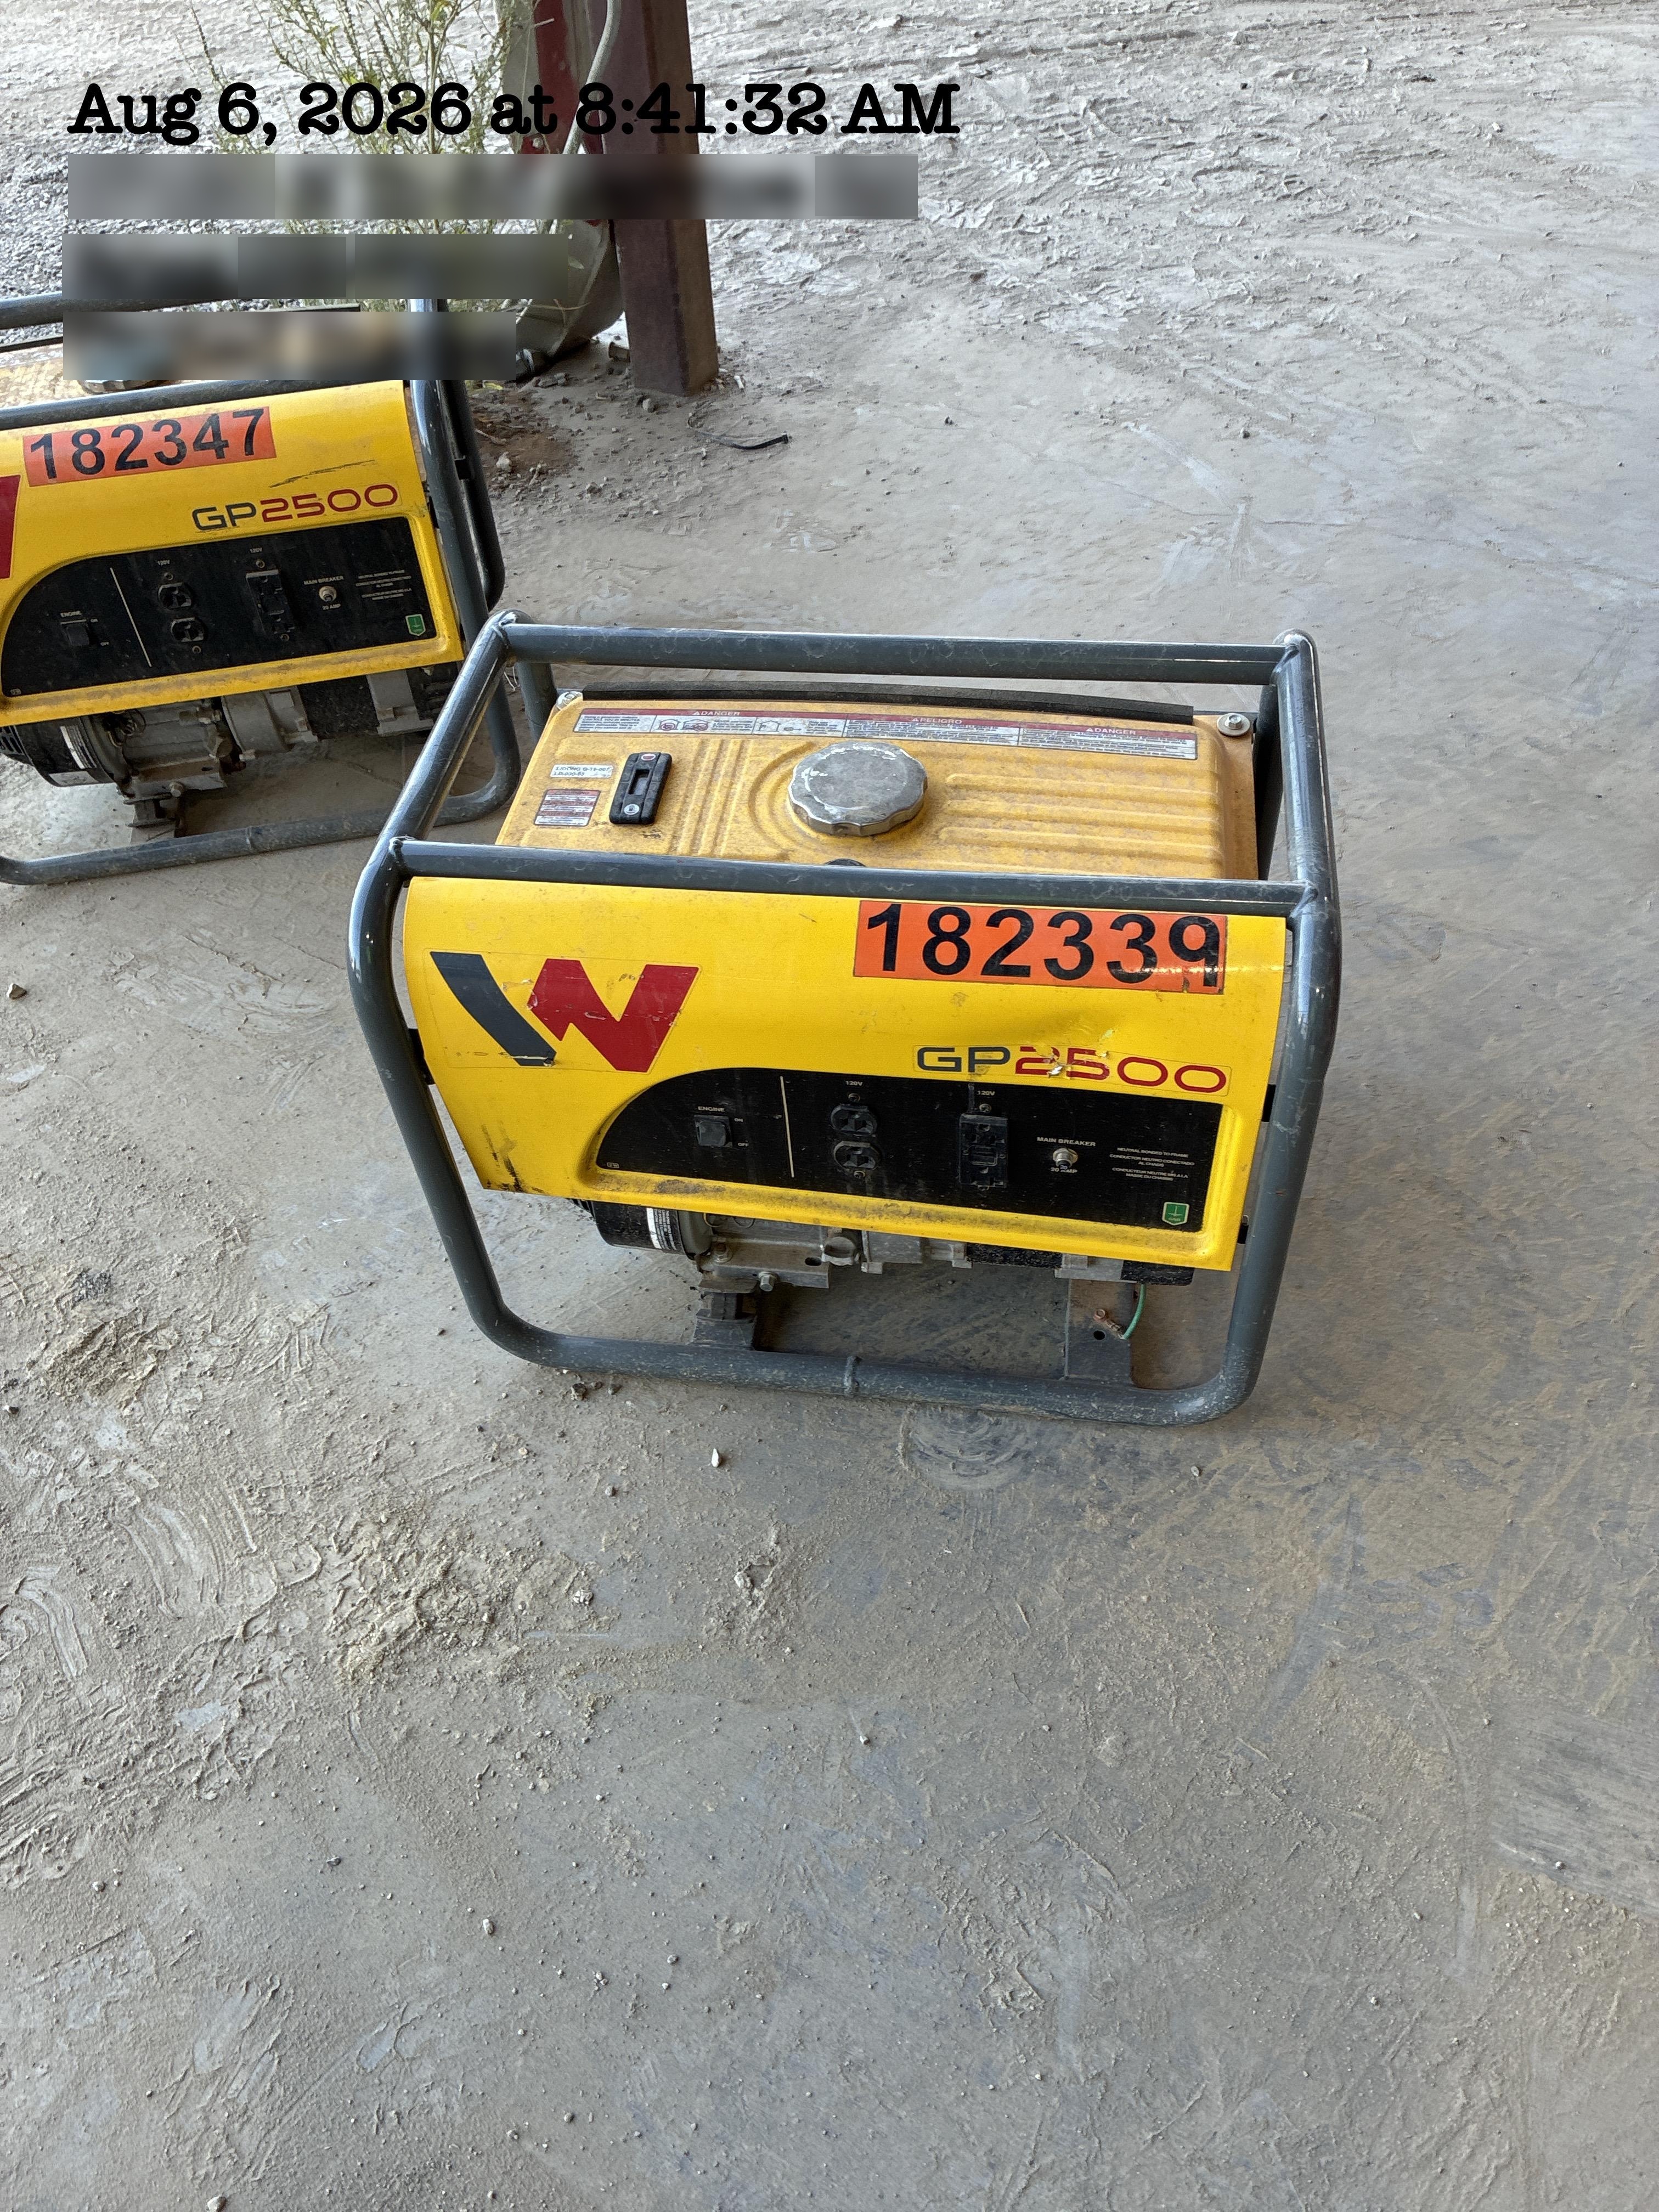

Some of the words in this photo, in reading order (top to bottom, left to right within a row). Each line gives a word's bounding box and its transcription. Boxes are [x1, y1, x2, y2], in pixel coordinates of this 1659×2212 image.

[30, 408, 266, 480] 182347
[191, 483, 399, 532] GP2500
[318, 575, 344, 584] BREAKER
[867, 902, 1222, 988] 182339
[916, 1045, 1227, 1094] GP2500
[1058, 1138, 1096, 1147] BREAKER
